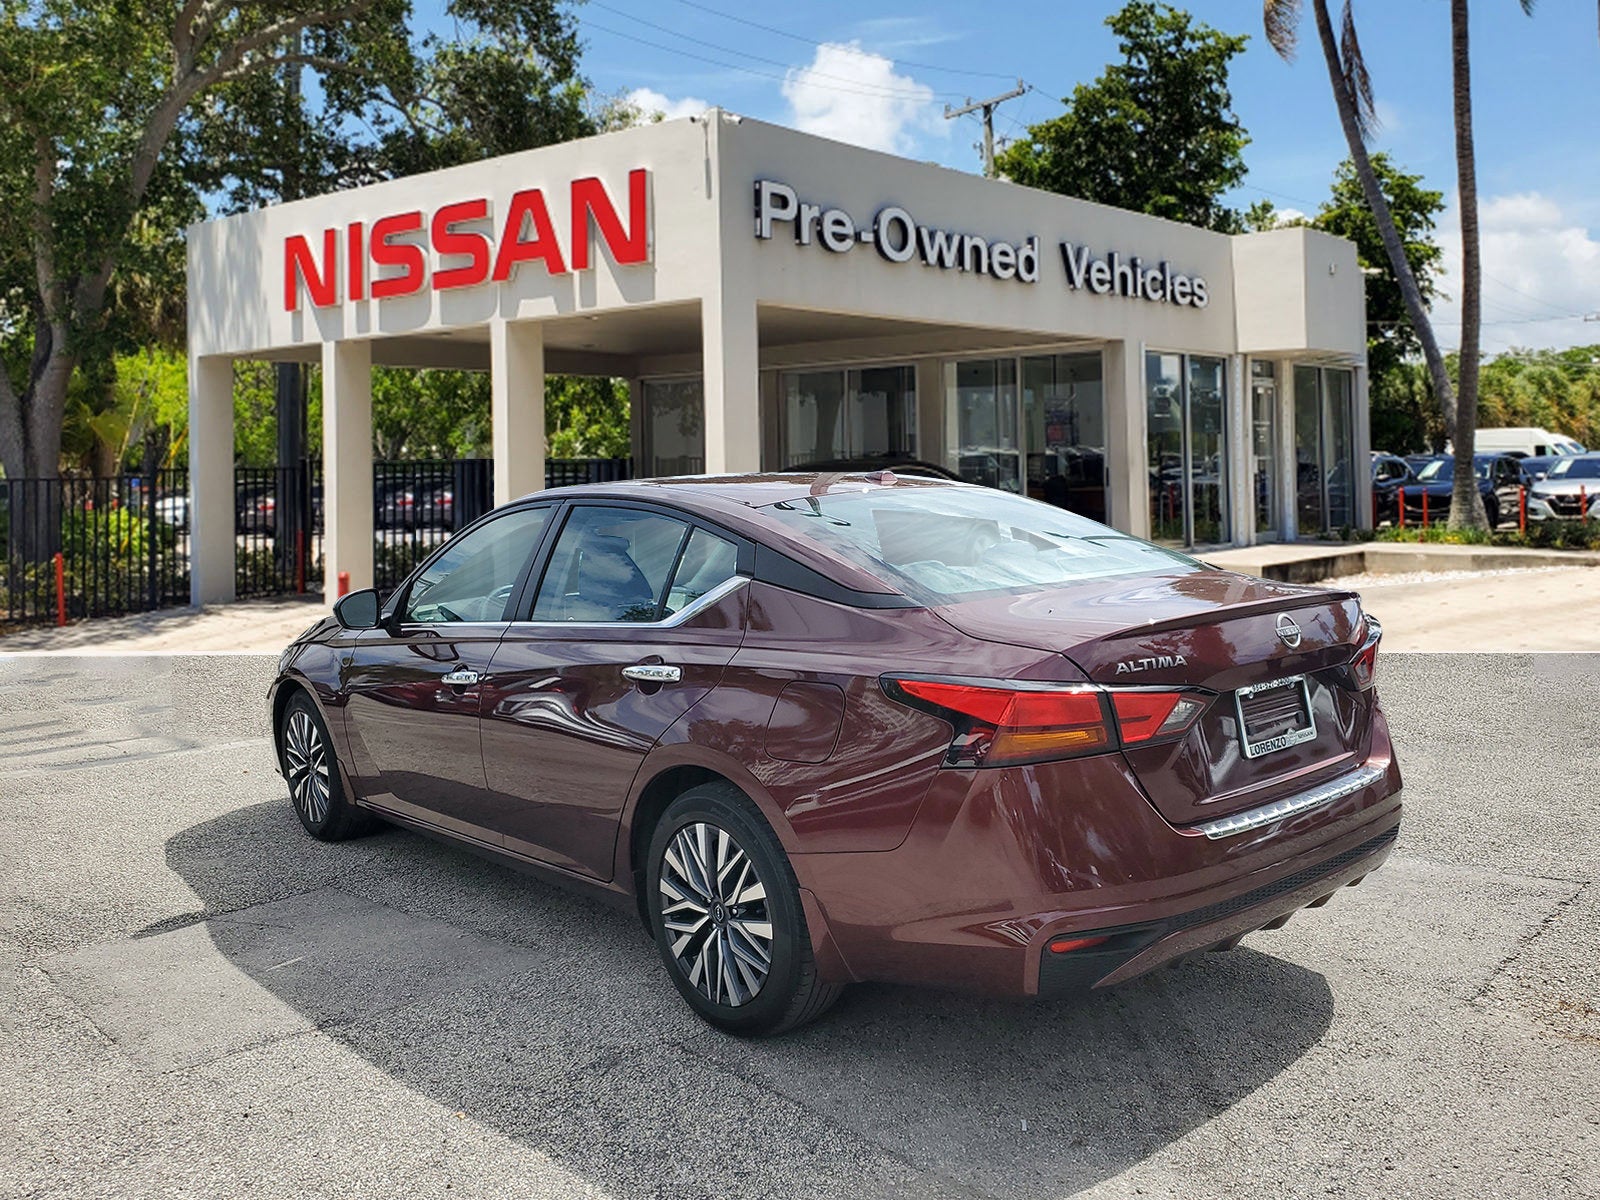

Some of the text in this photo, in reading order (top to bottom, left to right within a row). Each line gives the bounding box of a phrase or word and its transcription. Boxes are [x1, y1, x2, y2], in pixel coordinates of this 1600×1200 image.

[285, 168, 647, 311] NISSAN
[754, 179, 1208, 307] Pre-Owned Vehicles
[1115, 655, 1188, 675] ALTIMA
[1249, 737, 1287, 756] LORENZO
